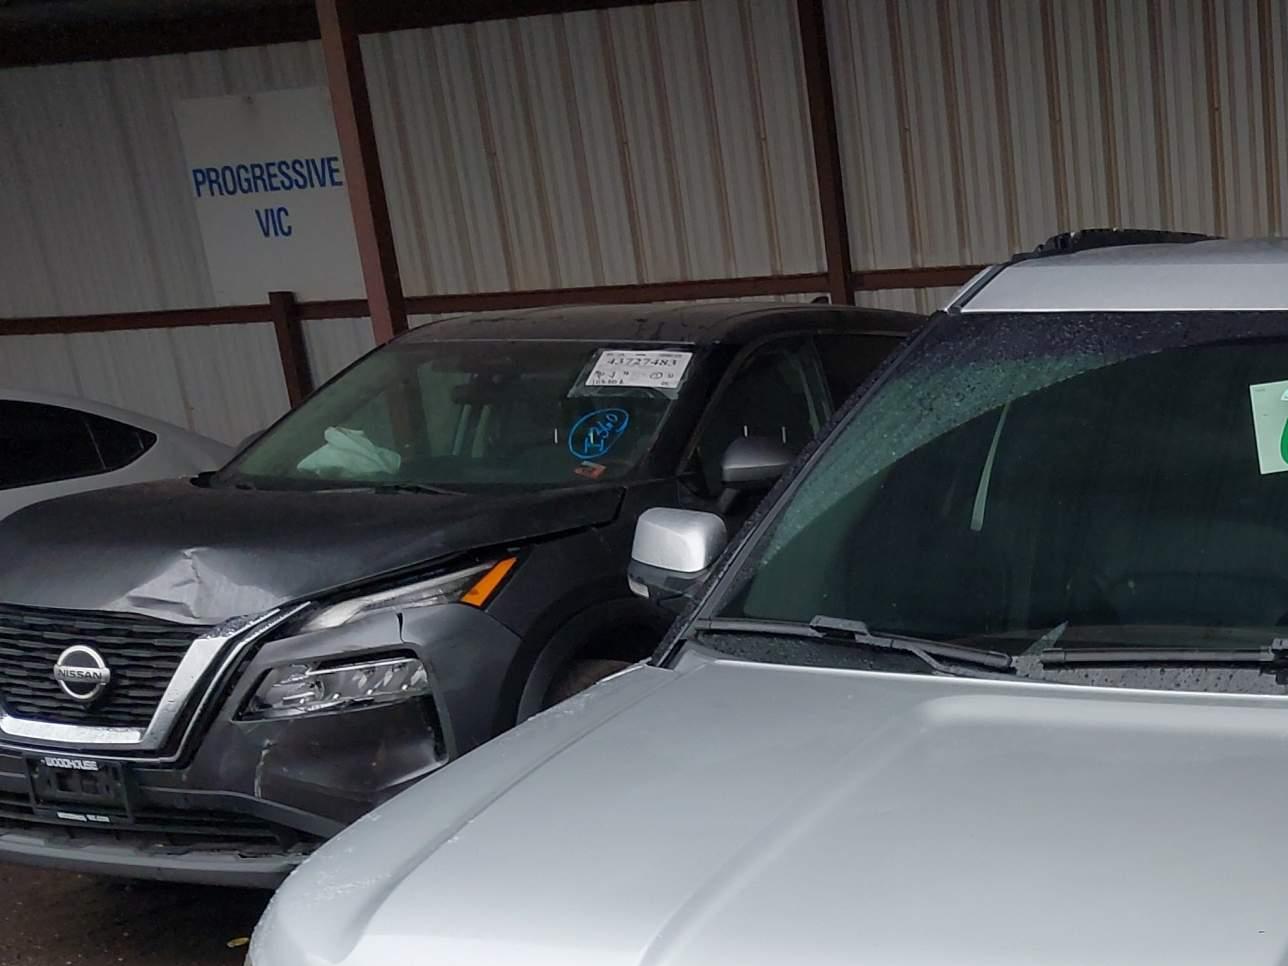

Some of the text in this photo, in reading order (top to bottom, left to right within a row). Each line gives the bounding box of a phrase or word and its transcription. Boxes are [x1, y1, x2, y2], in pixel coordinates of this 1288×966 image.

[192, 156, 344, 198] PROGRESSIVE
[255, 207, 292, 238] VIC
[57, 668, 102, 680] NISSAN
